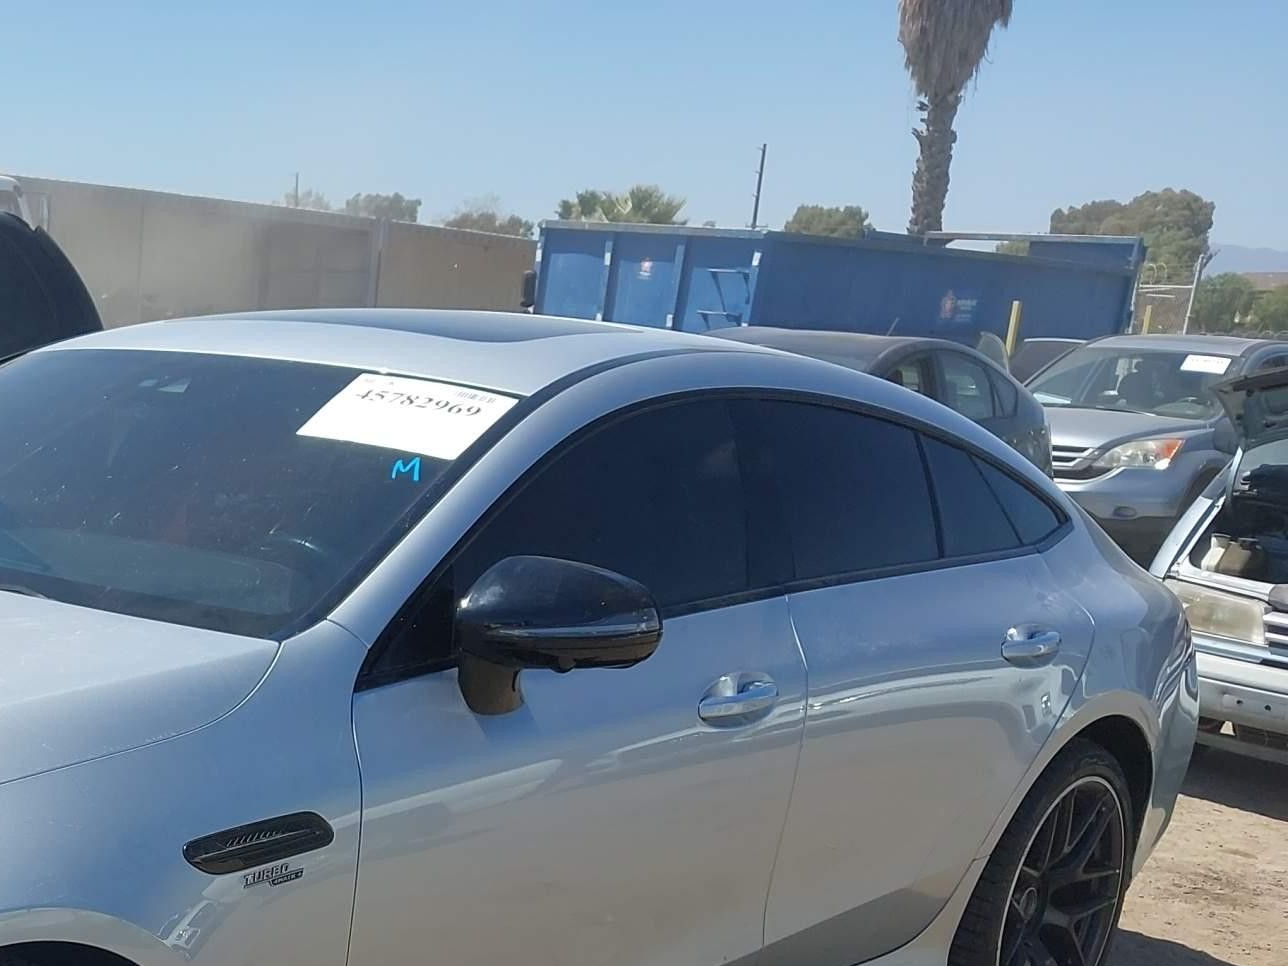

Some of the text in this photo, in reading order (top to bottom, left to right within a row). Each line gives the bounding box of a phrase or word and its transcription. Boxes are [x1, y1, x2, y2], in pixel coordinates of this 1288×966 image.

[355, 389, 482, 416] 45782969
[391, 456, 422, 481] M
[244, 862, 290, 886] TURBO
